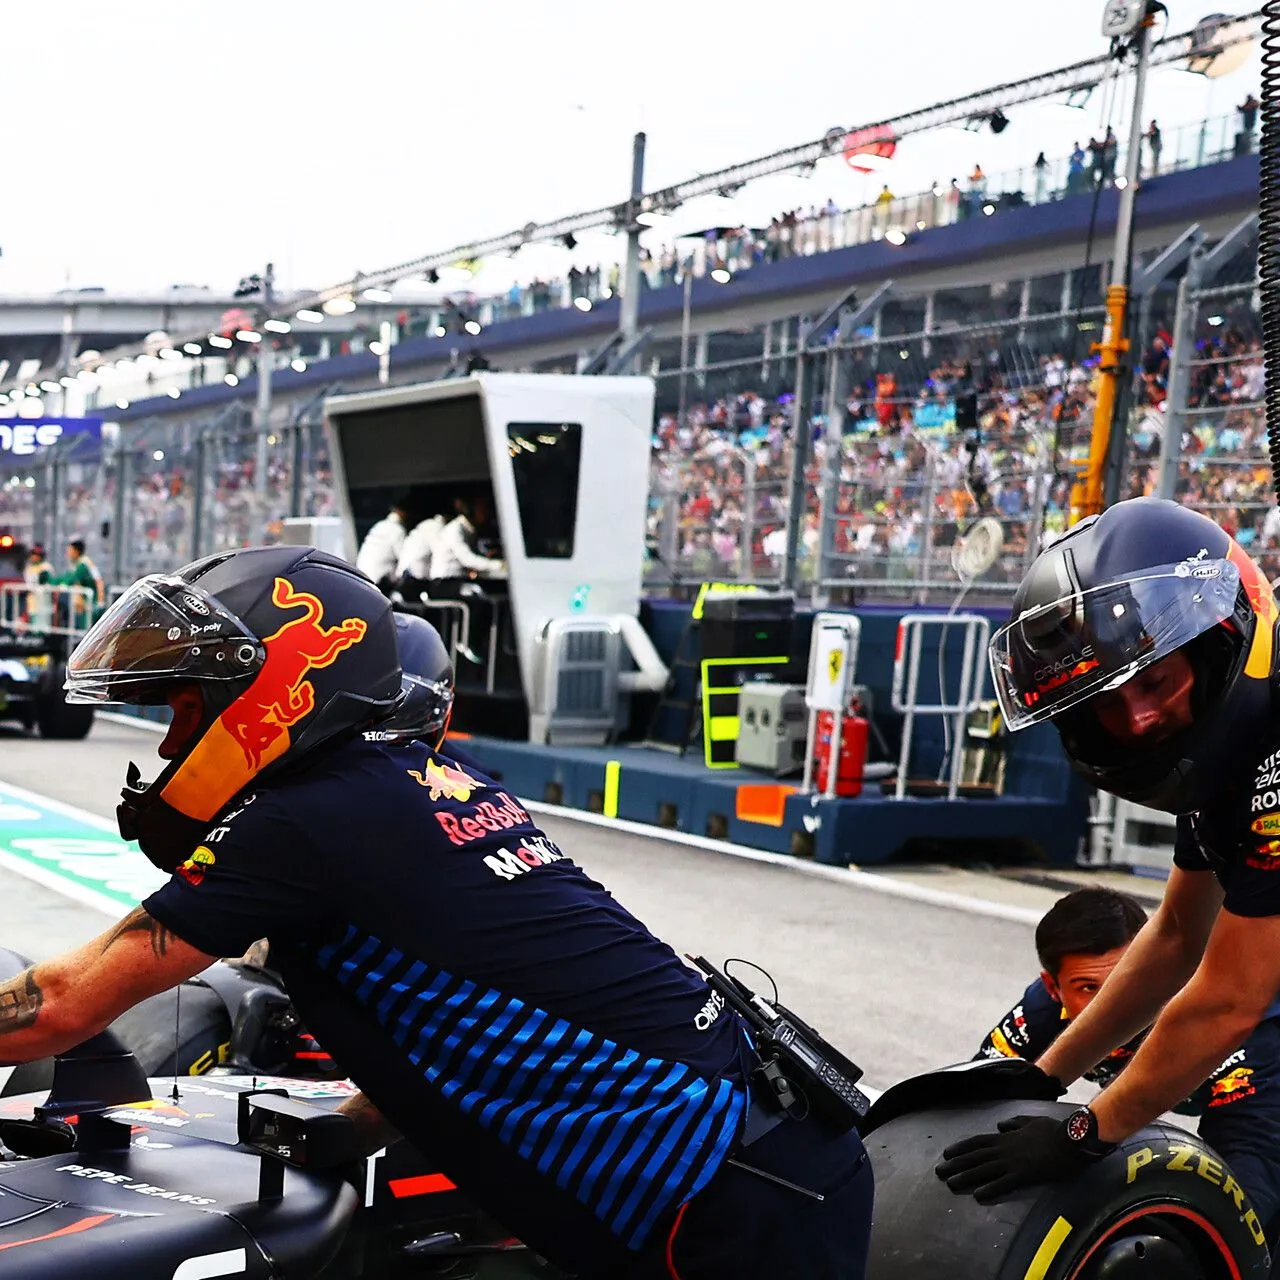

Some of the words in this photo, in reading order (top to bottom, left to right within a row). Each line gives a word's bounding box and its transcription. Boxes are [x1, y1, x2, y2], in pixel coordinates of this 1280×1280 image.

[203, 622, 222, 634] poly
[1035, 645, 1096, 682] ORACLE
[434, 802, 496, 846] Red
[56, 1163, 133, 1185] PEPE
[123, 1182, 217, 1207] JEANS
[1127, 1146, 1153, 1185] P
[1166, 1145, 1266, 1246] ZERO
